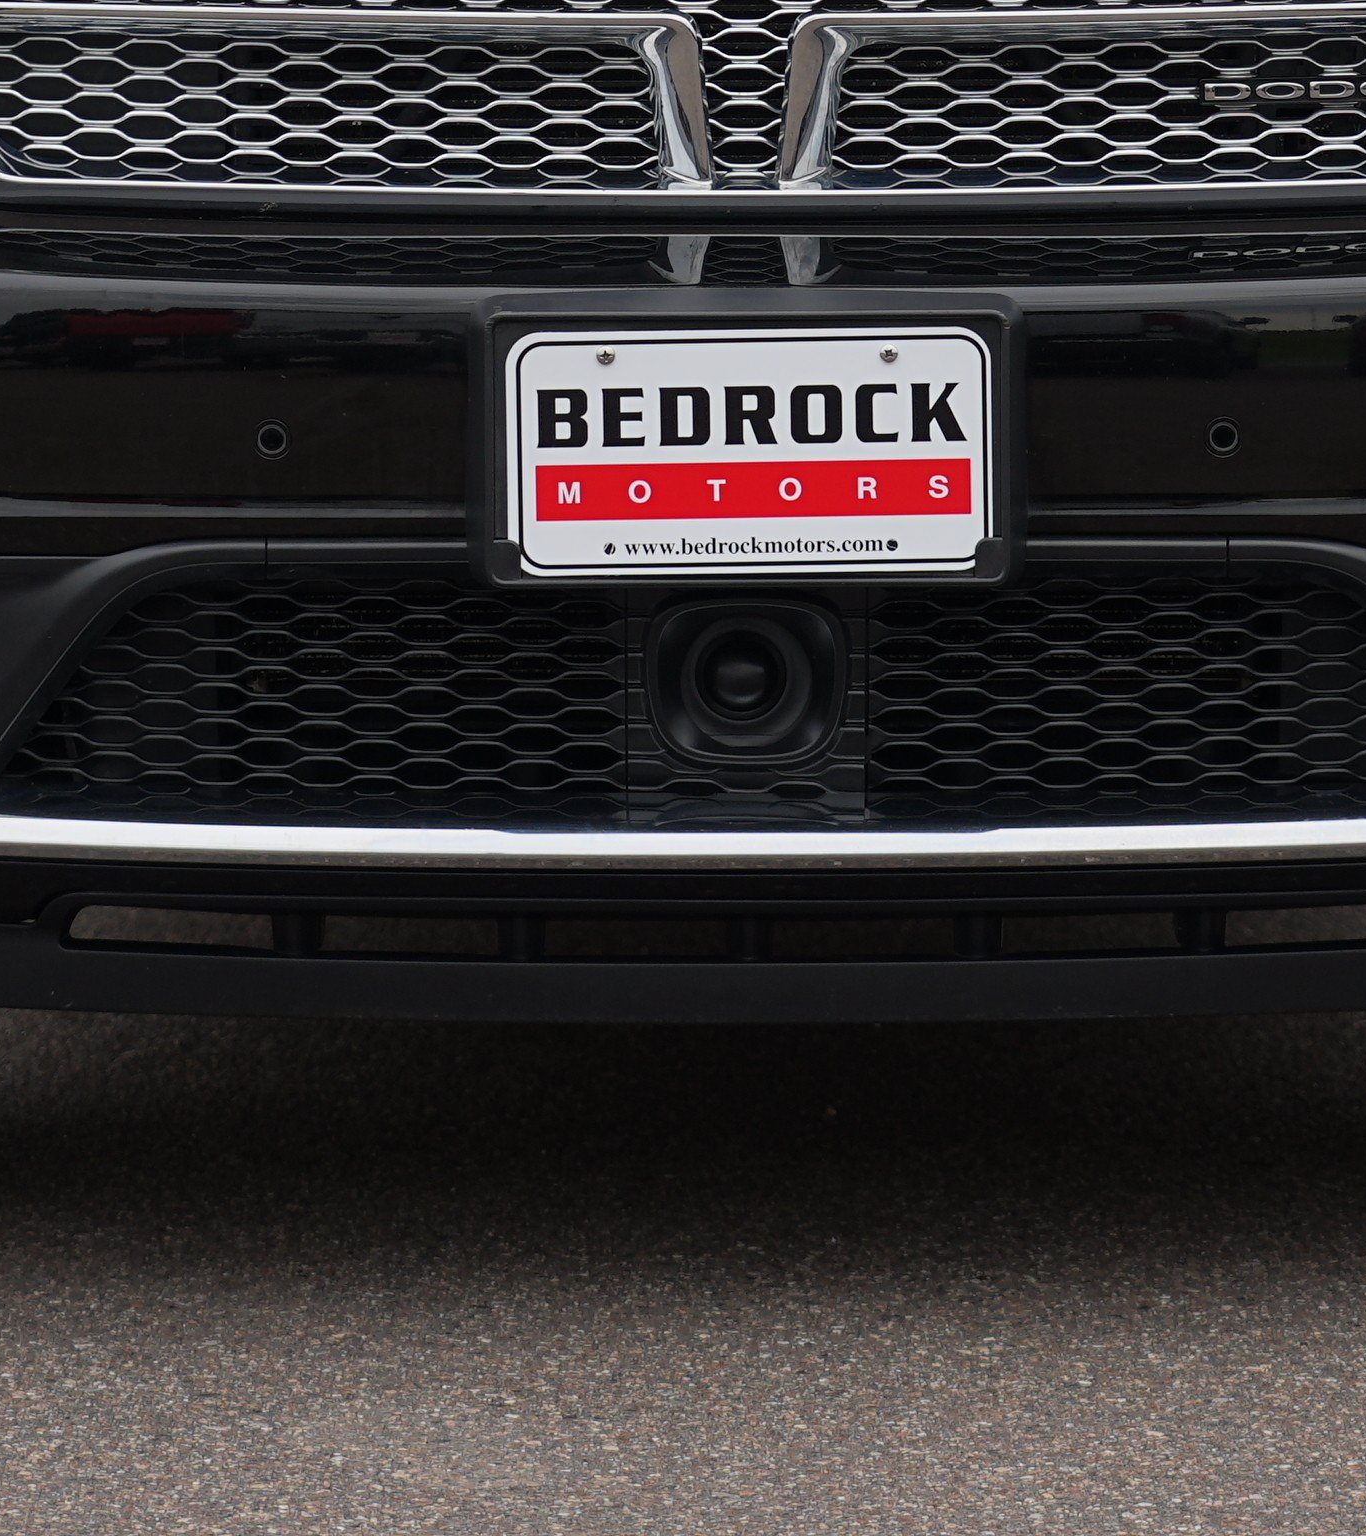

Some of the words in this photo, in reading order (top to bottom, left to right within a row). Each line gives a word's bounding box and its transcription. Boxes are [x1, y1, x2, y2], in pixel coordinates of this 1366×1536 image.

[537, 382, 968, 449] BEDROCK
[557, 475, 950, 505] MOTORS
[624, 536, 884, 557] www.bedrockmotors.com
